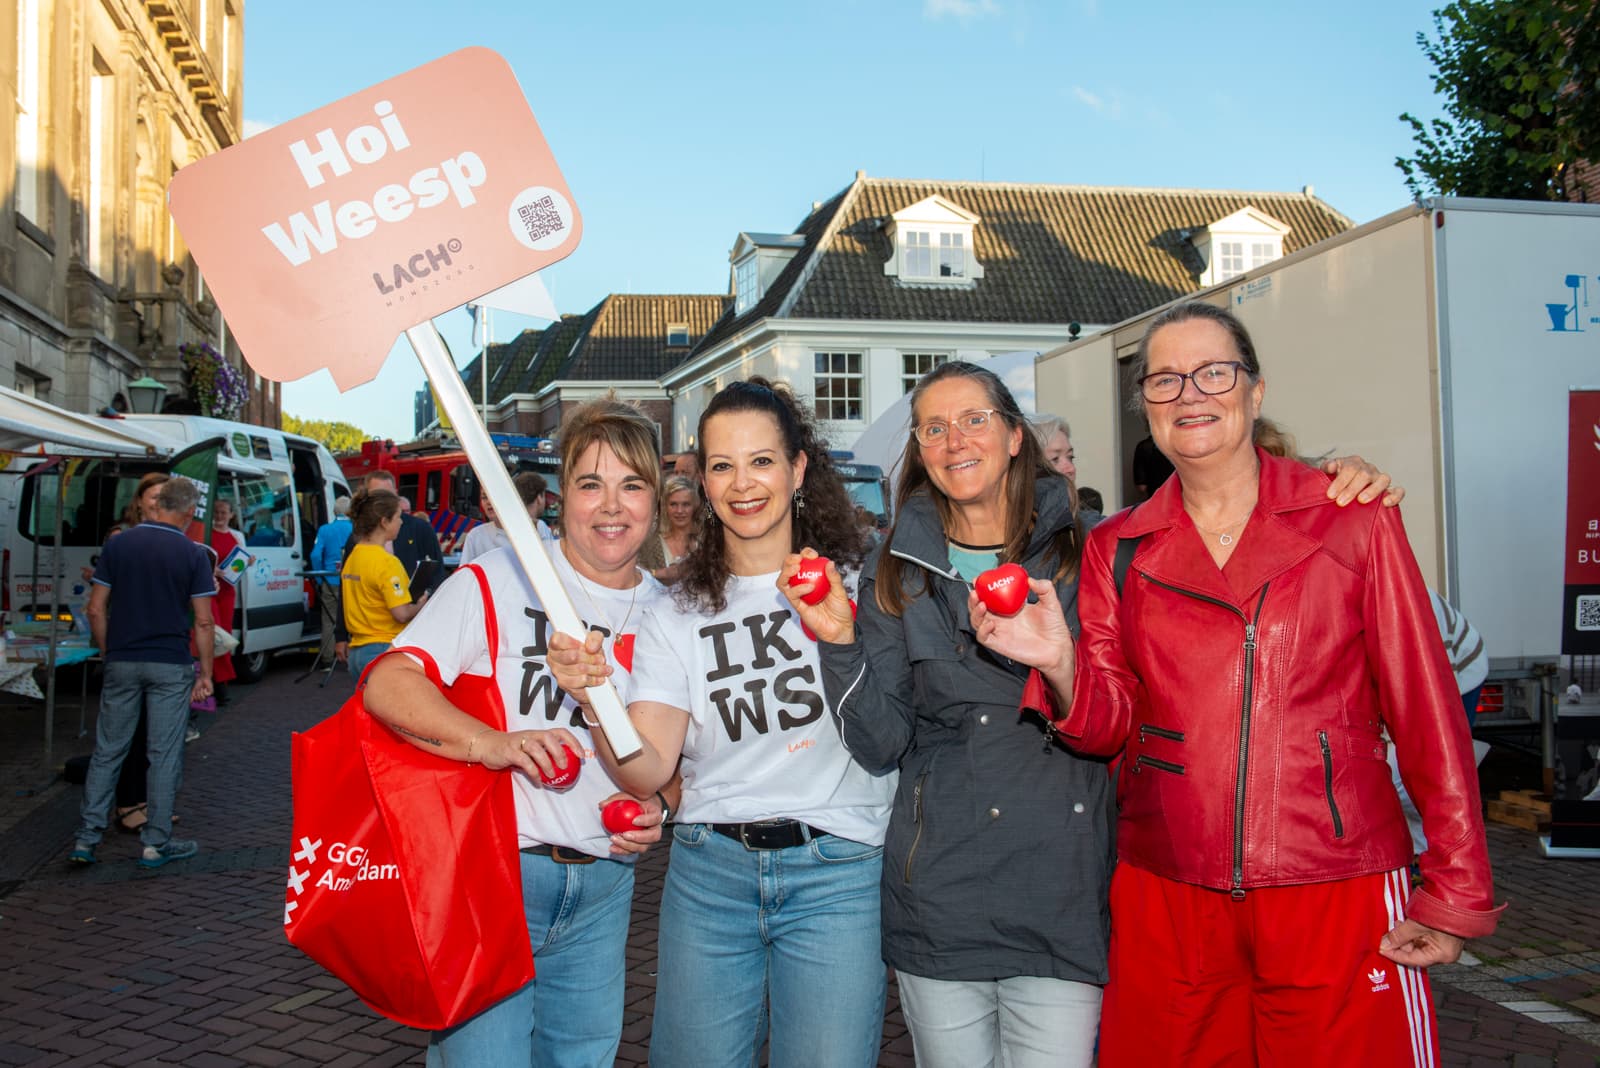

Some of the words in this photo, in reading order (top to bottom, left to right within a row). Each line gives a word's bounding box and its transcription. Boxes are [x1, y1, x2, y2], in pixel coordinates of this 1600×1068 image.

[289, 100, 411, 189] Hoi
[261, 151, 487, 267] Weesp
[373, 243, 452, 295] LACH
[699, 609, 802, 682] IK
[327, 842, 369, 867] GG
